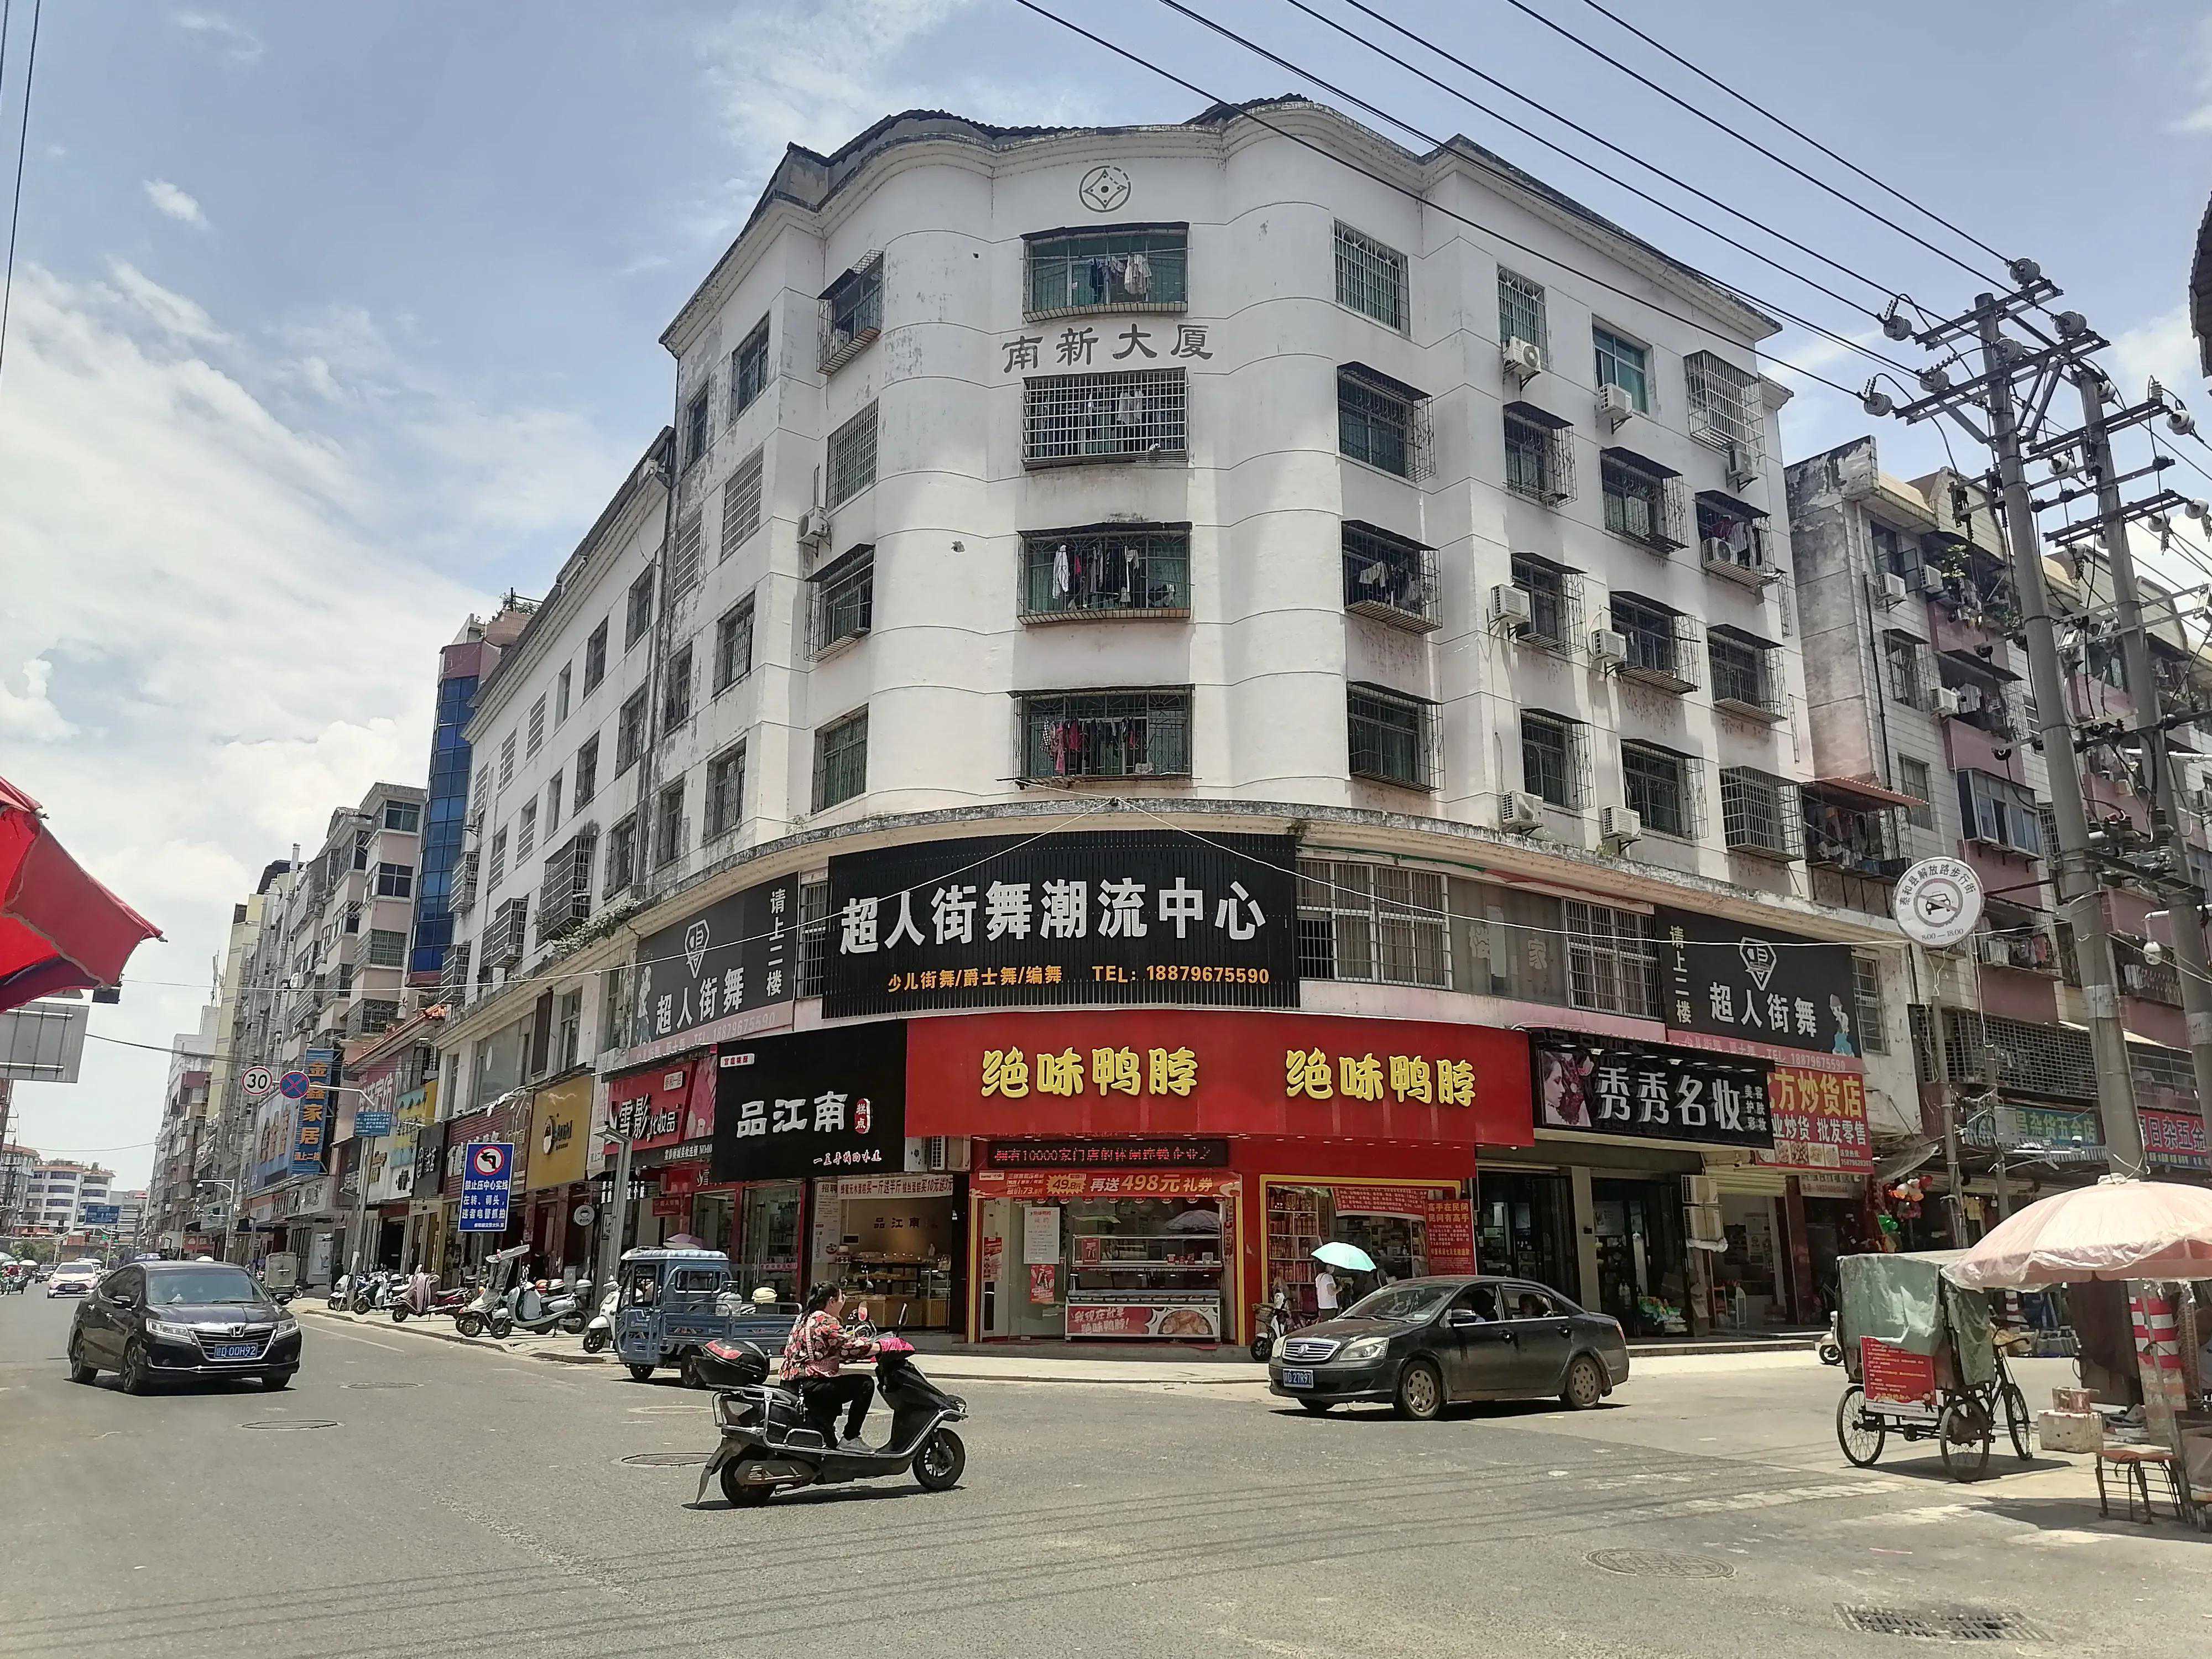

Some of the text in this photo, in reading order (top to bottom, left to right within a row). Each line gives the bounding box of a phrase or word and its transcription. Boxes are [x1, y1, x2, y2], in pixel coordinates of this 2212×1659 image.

[1001, 324, 1214, 373] 南新大厦
[1899, 864, 1976, 906] 泰和县解放路步行街
[840, 877, 1267, 955] 超人街舞潮流中心
[766, 888, 786, 997] 请上二楼
[888, 966, 1062, 993] 少儿街舞/爵士舞/编舞
[1146, 964, 1270, 984] 18879675590
[1669, 925, 1692, 1024] 请上二楼
[656, 967, 744, 1036] 超人街舞
[1709, 982, 1818, 1037] 超人街舞
[713, 1012, 776, 1041] 18879675590
[247, 1073, 268, 1090] 30
[981, 1046, 1198, 1098] 绝味鸭脖
[1286, 1047, 1476, 1107] 绝味鸭脖
[1791, 1052, 1846, 1071] 18879675590
[1597, 1067, 1744, 1131] 秀秀名妆
[1744, 1084, 1764, 1099] 美容
[1767, 1068, 1863, 1118] 方炒货店
[737, 1091, 849, 1138] 品江南
[855, 1102, 867, 1131] 糕点
[1817, 1117, 1866, 1146] 批发零售
[1091, 1173, 1213, 1193] 再送498元礼券
[874, 1217, 920, 1229] 品江南
[1428, 1202, 1469, 1212] 高手在民间
[1428, 1213, 1469, 1223] 民间有高手
